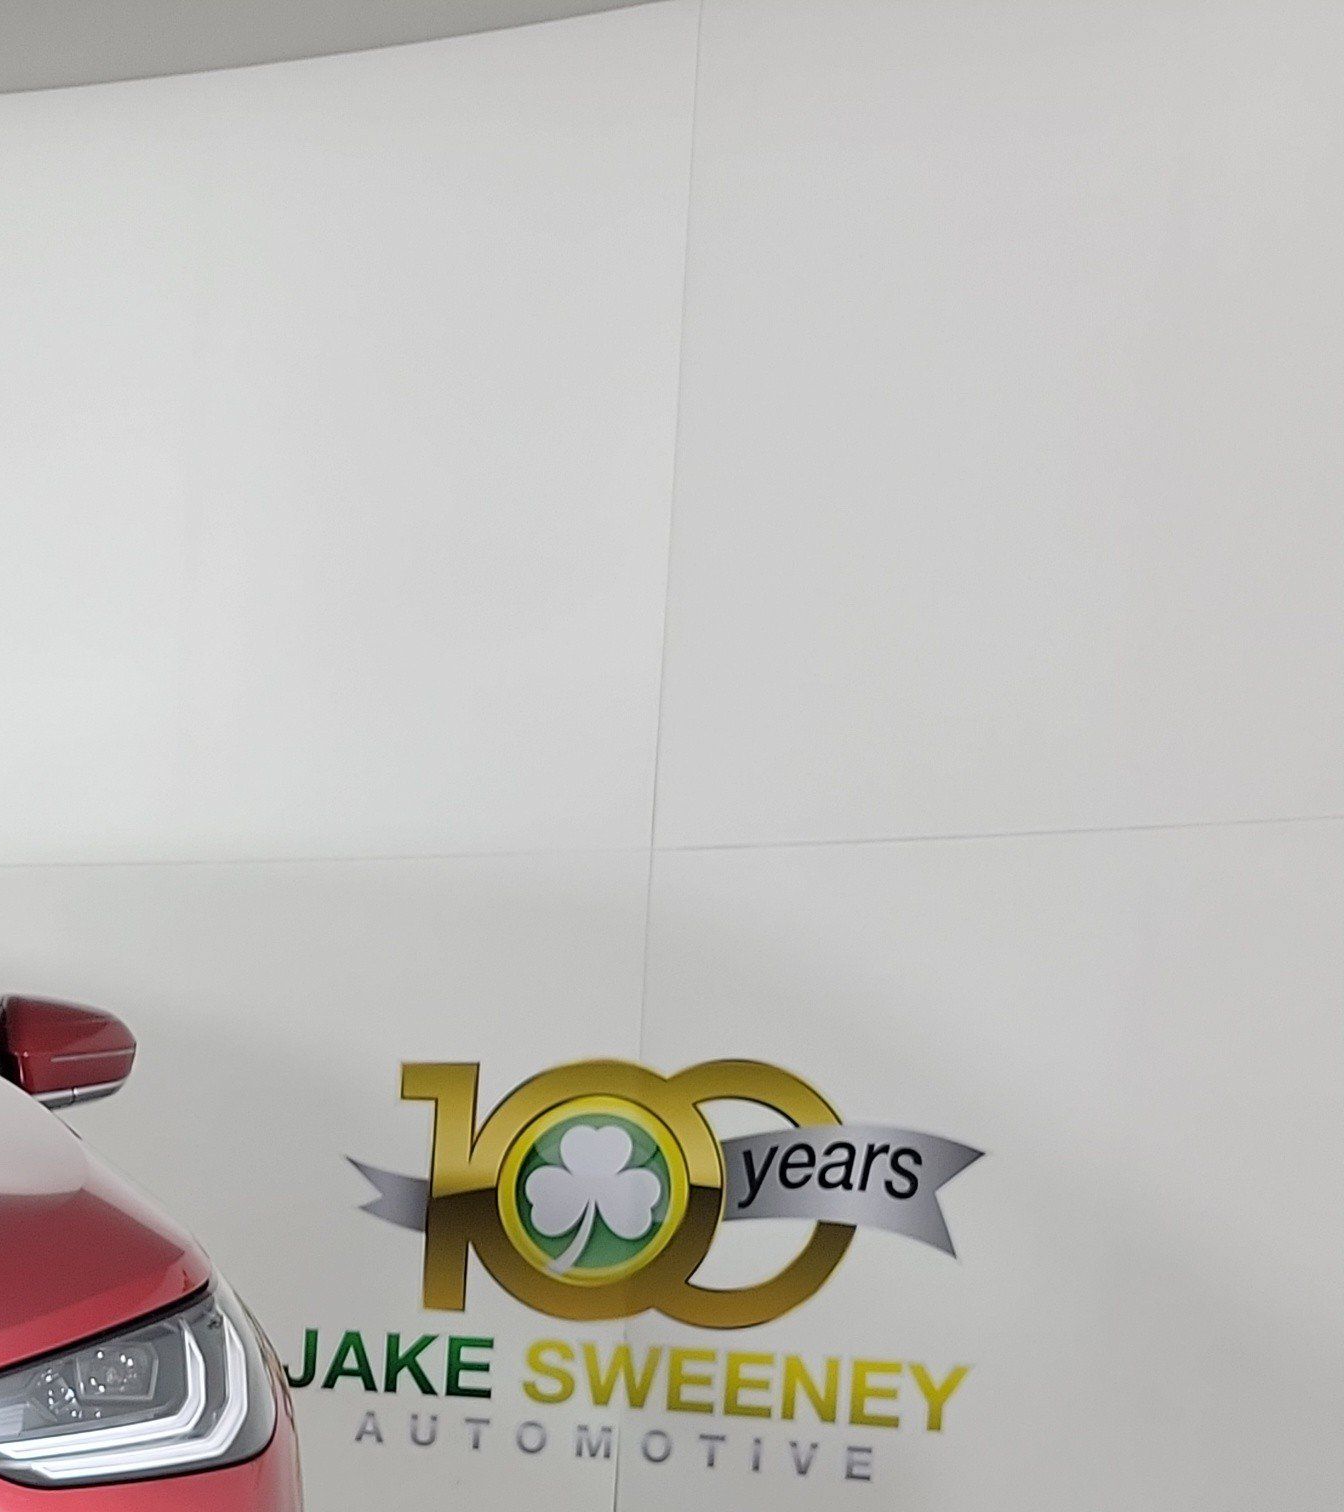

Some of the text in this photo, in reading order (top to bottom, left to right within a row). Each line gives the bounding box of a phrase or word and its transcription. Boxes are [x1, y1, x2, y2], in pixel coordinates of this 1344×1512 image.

[400, 1058, 924, 1330] 100 years
[283, 1328, 972, 1434] JAKE SWEENEY
[355, 1410, 874, 1483] AUTOMOTIVE
